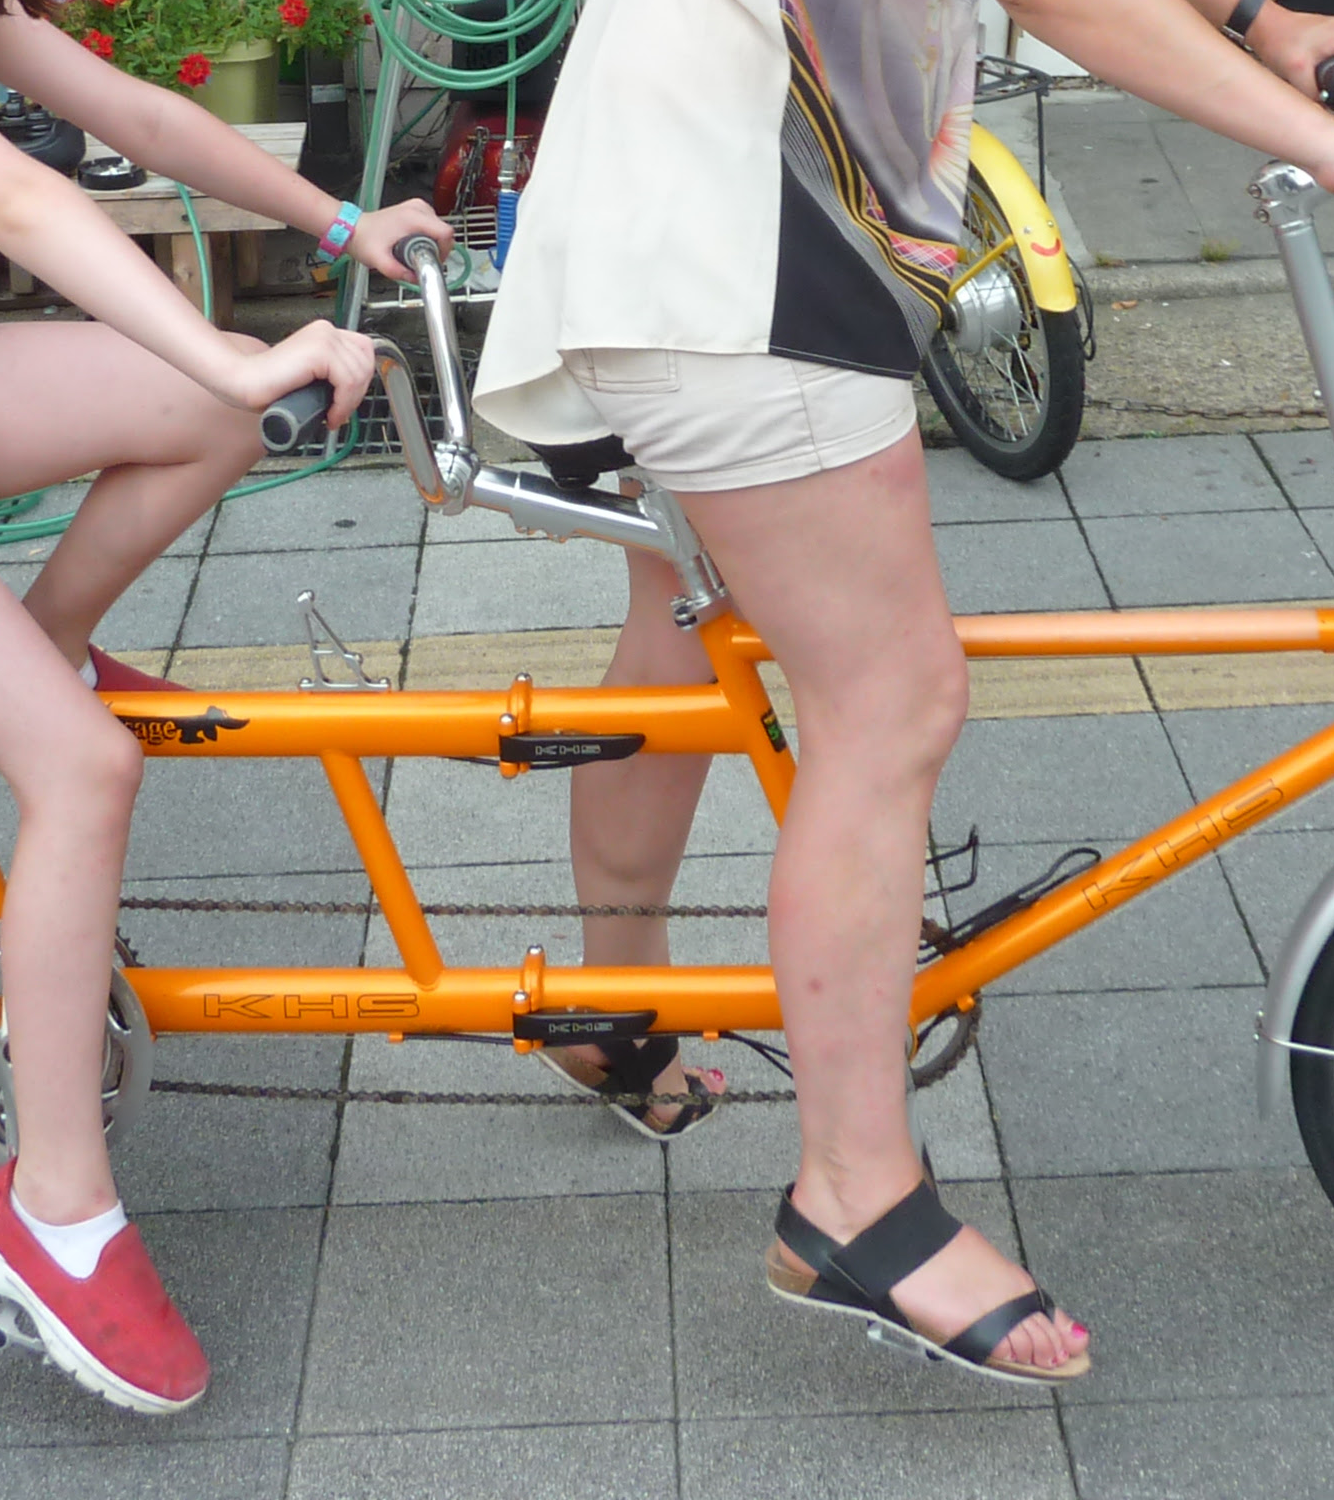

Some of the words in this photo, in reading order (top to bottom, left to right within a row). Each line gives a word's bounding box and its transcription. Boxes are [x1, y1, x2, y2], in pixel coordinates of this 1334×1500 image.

[1082, 778, 1284, 911] KHS
[203, 992, 420, 1020] KHS
[549, 1021, 614, 1033] KHS
